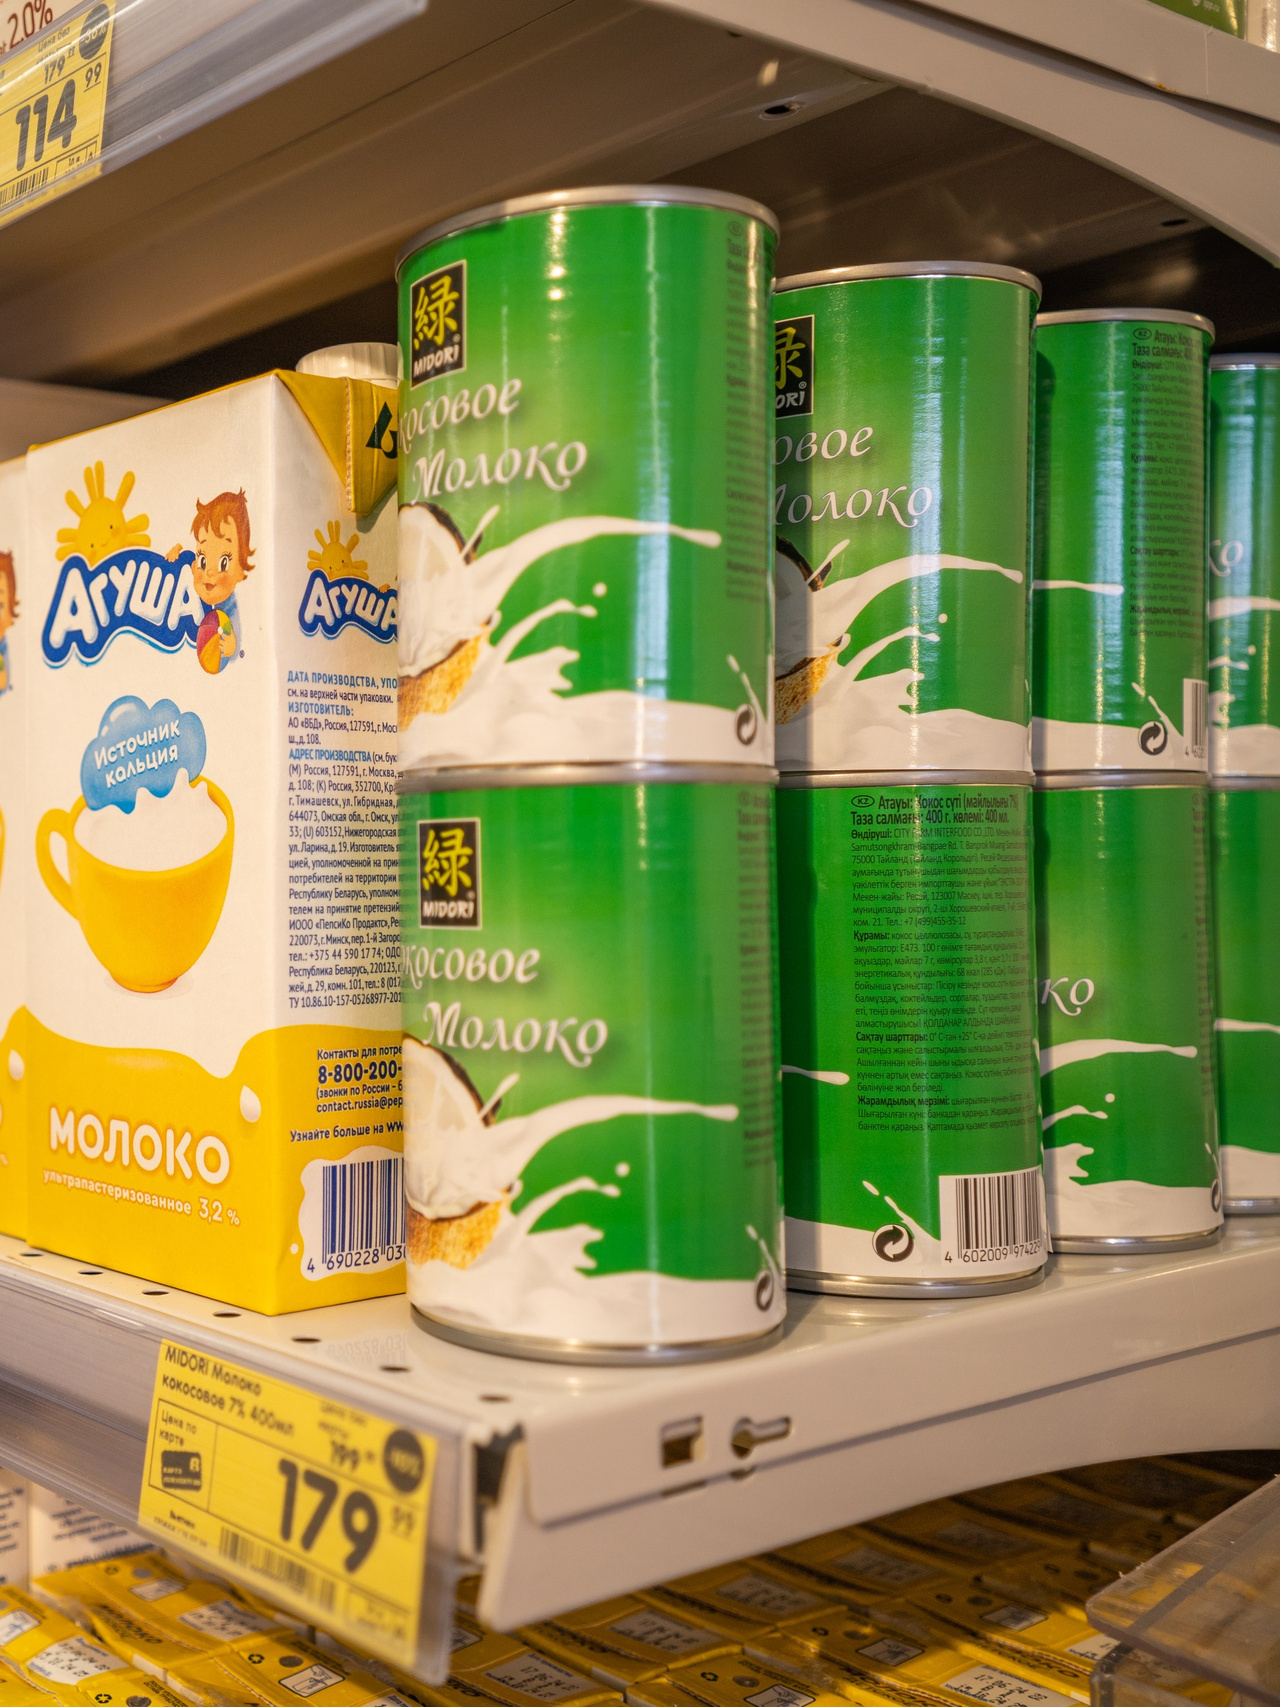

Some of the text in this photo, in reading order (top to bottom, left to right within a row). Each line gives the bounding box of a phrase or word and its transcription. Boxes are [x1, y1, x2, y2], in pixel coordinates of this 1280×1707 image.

[15, 79, 77, 172] 114
[85, 62, 102, 88] 99
[412, 270, 461, 351] 緑
[413, 342, 461, 377] MIDORI
[411, 440, 588, 504] Молоко
[288, 670, 379, 689] ДАТА ПРОИЗВОДСТВА,
[310, 689, 393, 704] верхней части упаковки.
[288, 702, 354, 716] ИЗГОТОВИТЕЛЬ:
[288, 717, 377, 733] АО Россия, 127591,
[93, 720, 181, 769] Источник
[306, 733, 321, 745] 108.
[289, 749, 372, 762] АДРЕС ПРОИЗВОДСТВА
[105, 745, 180, 788] кальция
[289, 764, 397, 779] (М) Россия, 127591, Москва,
[328, 780, 354, 793] Россия,
[355, 781, 383, 793] 352700,
[295, 795, 395, 809] Тимашевск, Гибридная,
[878, 795, 913, 813] Атауы:
[945, 793, 962, 812] сүті
[289, 811, 391, 824] 644073, Омская Омск,
[851, 811, 873, 825] Таза
[926, 809, 943, 824] 400
[953, 808, 984, 823] көлемі:
[985, 809, 998, 823] 400
[316, 826, 397, 839] 603152, Нижегородская
[851, 829, 892, 841] Өндіруші:
[301, 842, 394, 855] Ларина, Изготовитель
[289, 857, 381, 870] цией, уполномоченной на
[422, 827, 474, 897] 緑
[289, 873, 397, 886] потребителей на территории
[289, 888, 368, 901] Республику Беларусь,
[289, 902, 400, 916] телем на принятие претензий
[422, 900, 475, 919] MIDORI
[289, 918, 390, 931] ИООО «ПепсиКо Продактс»,
[289, 934, 365, 947] 220073, Минск, пер.
[853, 930, 890, 942] Құрамы:
[310, 947, 384, 960] +375 44 590 17 74;
[289, 962, 397, 979] Республика Беларусь, 220123,
[289, 979, 364, 994] жей, комн. 101,
[289, 997, 299, 1008] ТУ
[421, 1001, 608, 1068] Молоко
[856, 1031, 928, 1044] Сақтау шарттары:
[317, 1047, 377, 1060] Контакты для
[317, 1084, 390, 1100] (звонки по России
[857, 1095, 917, 1107] Жарамдылық
[290, 1124, 384, 1142] Узнайте больше на
[49, 1107, 231, 1184] МОЛОКО
[43, 1167, 241, 1226] ультрапастеризованное 3,2 %
[306, 1247, 380, 1273] 4 690228
[944, 1251, 953, 1264] 4
[962, 1247, 1008, 1263] 602009
[165, 1346, 262, 1397] MIDORI Молоко
[162, 1374, 225, 1410] кокосовое
[161, 1410, 197, 1435] Цена по
[160, 1428, 184, 1447] карте
[277, 1457, 380, 1575] 179
